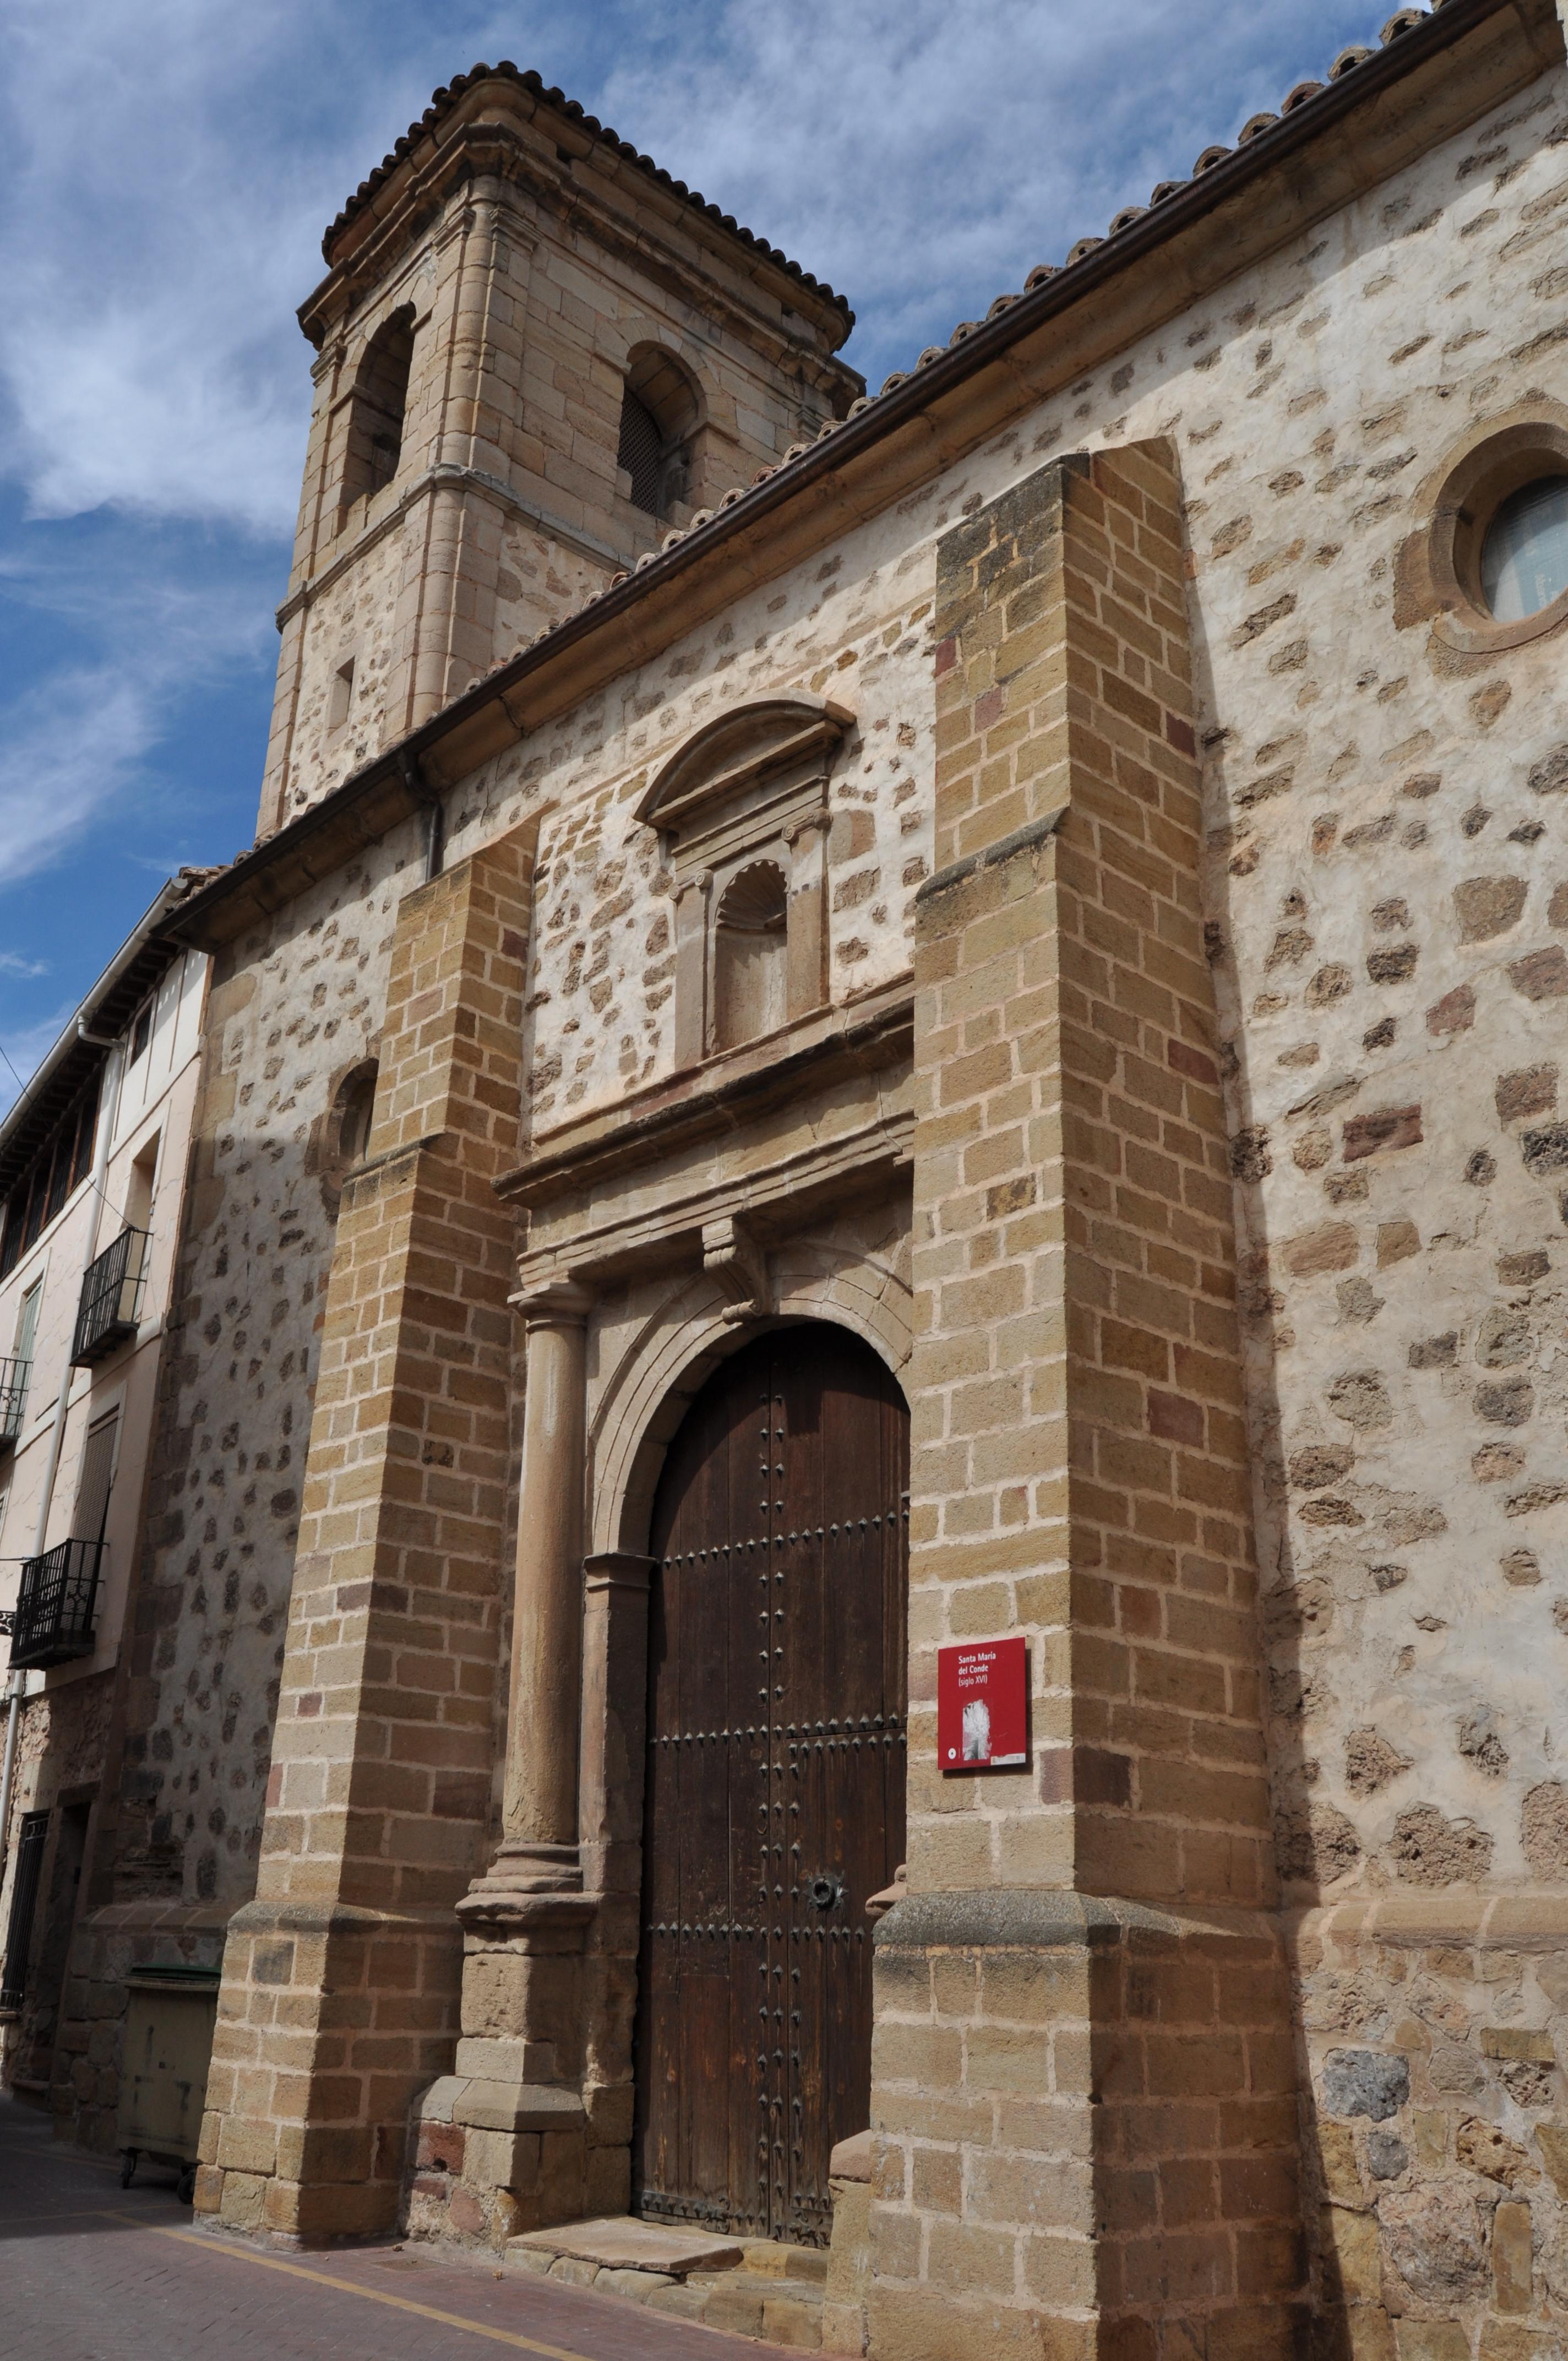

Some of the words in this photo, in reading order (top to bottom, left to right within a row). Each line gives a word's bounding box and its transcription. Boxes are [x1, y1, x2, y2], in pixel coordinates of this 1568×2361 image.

[959, 1655, 976, 1664] Santa
[978, 1651, 996, 1661] María
[959, 1666, 967, 1675] del
[970, 1664, 988, 1673] Conde
[959, 1677, 974, 1688] (siglo
[976, 1674, 988, 1684] XVI)
